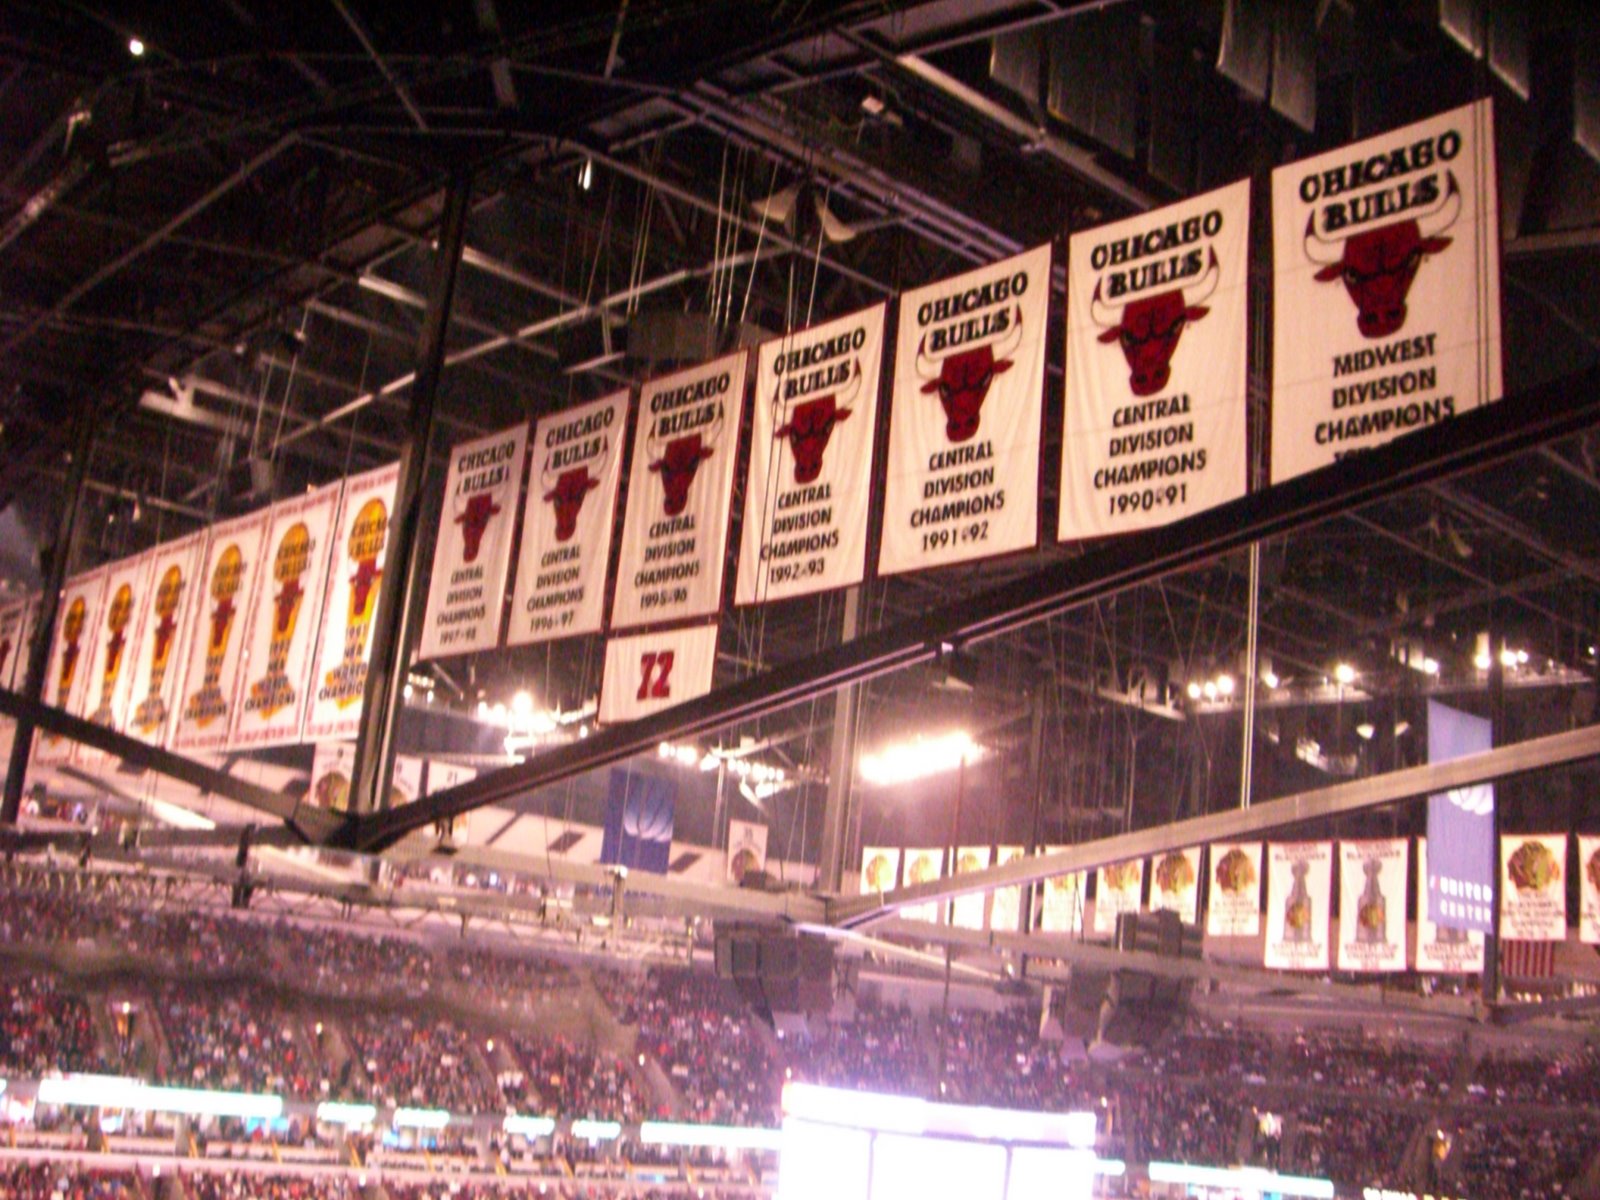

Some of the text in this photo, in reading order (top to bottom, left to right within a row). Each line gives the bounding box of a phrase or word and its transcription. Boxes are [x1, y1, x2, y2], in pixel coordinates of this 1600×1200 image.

[1299, 129, 1462, 204] CHICAGO
[1323, 174, 1440, 233] BULLS
[1090, 209, 1224, 271] CHICAGO
[1108, 246, 1204, 299] BULLS
[917, 271, 1029, 327] CHICAGO
[930, 307, 1010, 353] BULLS
[774, 327, 866, 376] CHICAGO
[1332, 333, 1437, 378] MIDWEST
[651, 373, 730, 414] CHICAGO
[784, 358, 851, 401] BULLS
[1332, 366, 1437, 409] DIVISION
[546, 405, 614, 448] CHICAGO
[658, 402, 715, 437] BULLS
[1112, 393, 1191, 428] CENTRAL
[1314, 396, 1455, 445] CHAMPIONS
[458, 440, 515, 473] CHICAGO
[552, 437, 601, 469] BULLS
[928, 440, 994, 472] CENTRAL
[1109, 421, 1194, 457] DIVISION
[463, 464, 503, 493] BULLS
[923, 466, 995, 499] DIVISION
[1093, 448, 1207, 489] CHAMPIONS
[778, 483, 831, 510] CENTRAL
[910, 490, 1005, 528] CHAMPIONS
[649, 515, 695, 539] CENTRAL
[773, 506, 832, 535] DIVISION
[541, 545, 580, 567] CENTRAL
[645, 538, 695, 563] DIVISION
[760, 529, 839, 562] CHAMPIONS
[451, 566, 483, 584] CENTRAL
[536, 566, 580, 589] DIVISION
[634, 560, 699, 588] CHAMPIONS
[446, 587, 483, 606] DIVISION
[526, 587, 584, 612] CHAMPIONS
[318, 680, 363, 701] CHAMPIO
[637, 651, 675, 699] 72
